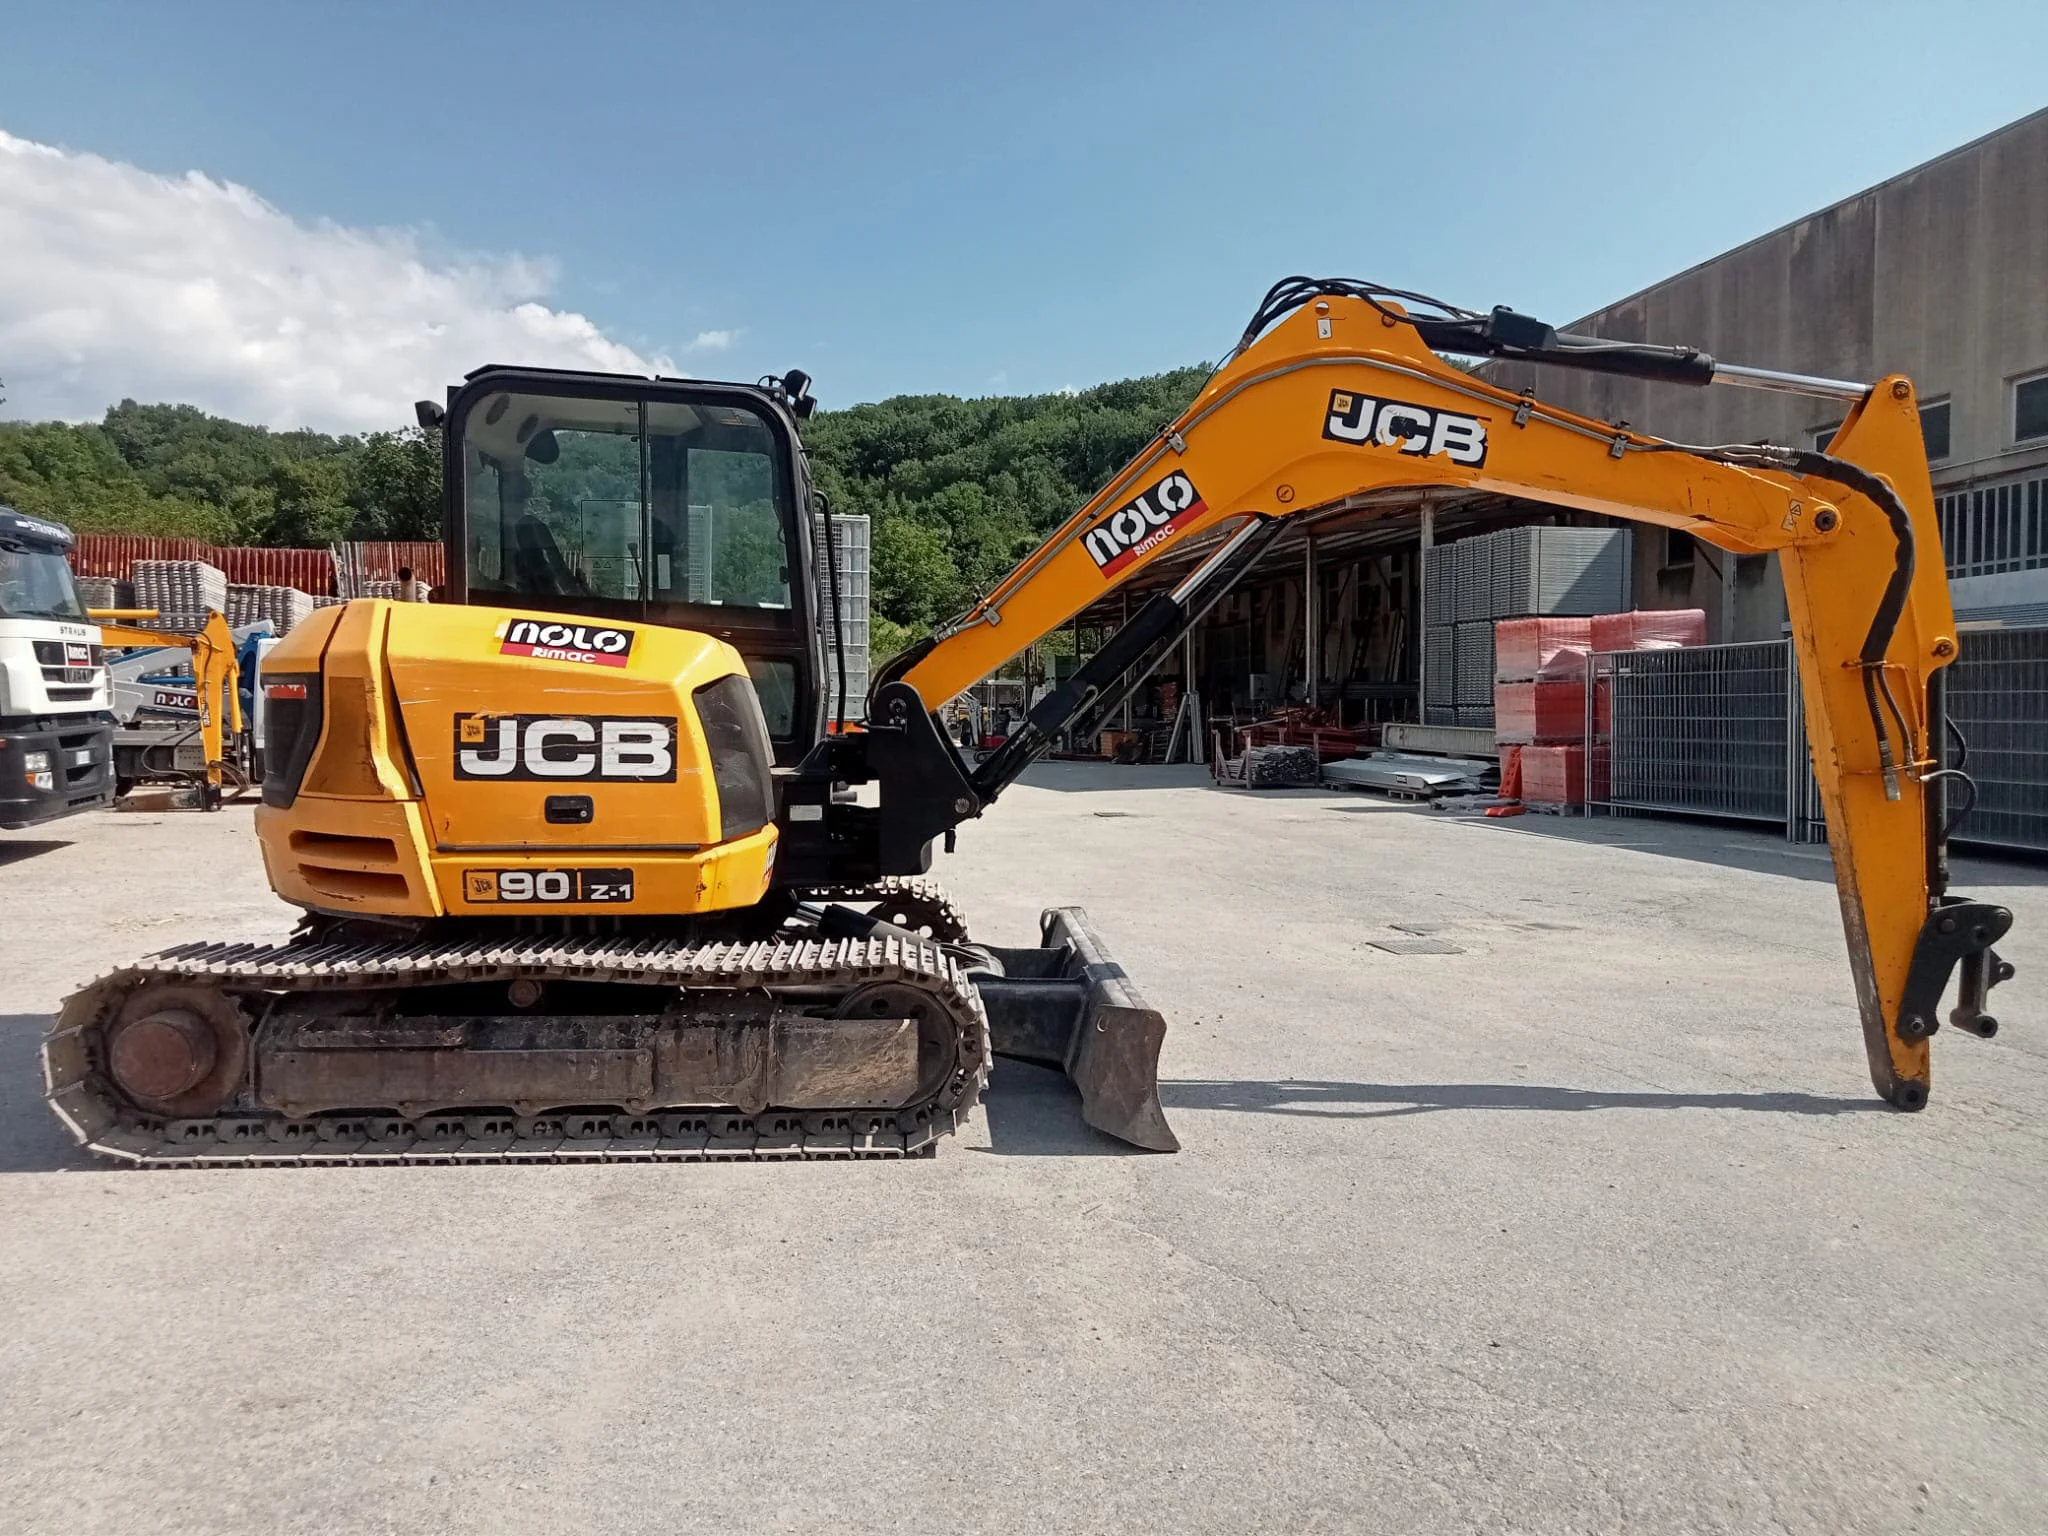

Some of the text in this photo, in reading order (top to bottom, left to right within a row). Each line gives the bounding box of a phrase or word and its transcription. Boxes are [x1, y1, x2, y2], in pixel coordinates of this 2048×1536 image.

[1329, 399, 1486, 462] JCB
[460, 719, 671, 776] JCB
[500, 872, 632, 900] 90 Z-1
